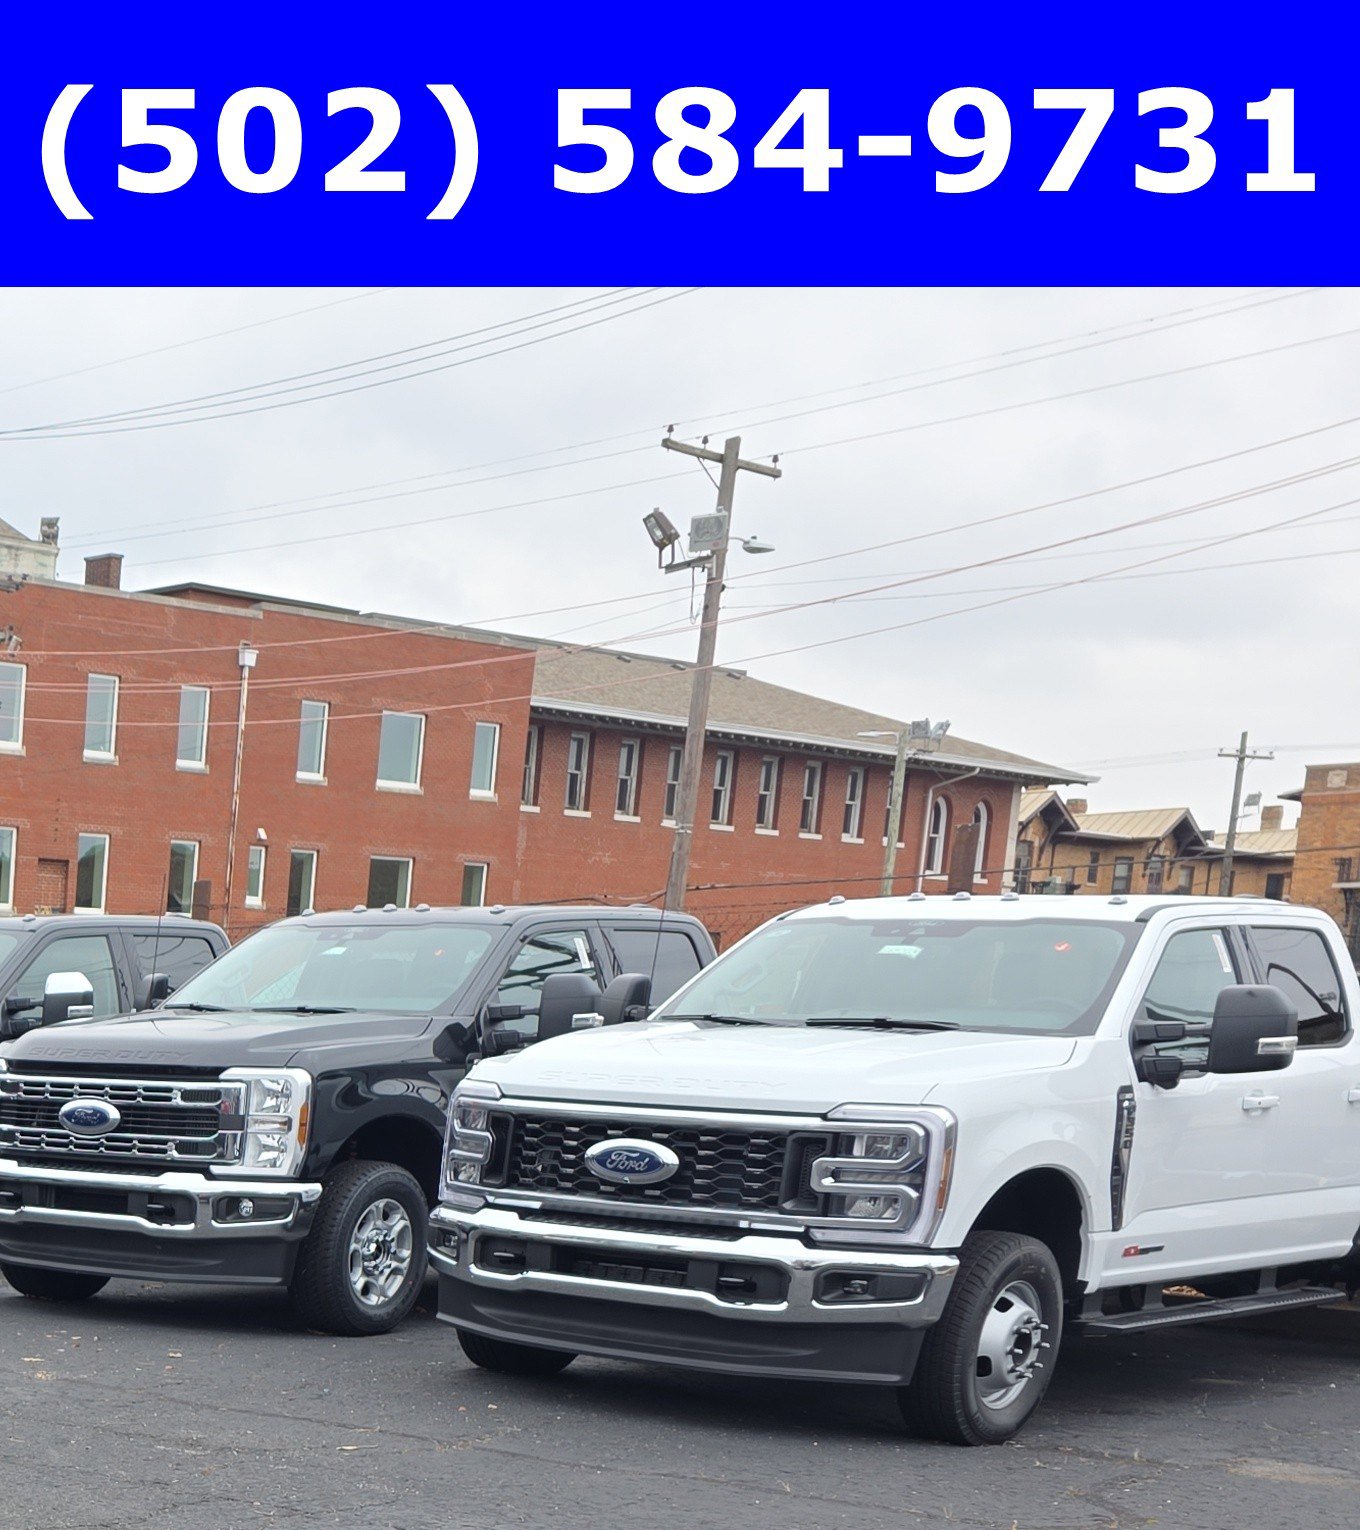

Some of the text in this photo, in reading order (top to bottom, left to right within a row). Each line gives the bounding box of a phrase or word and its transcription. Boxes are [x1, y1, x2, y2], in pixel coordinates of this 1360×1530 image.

[26, 1046, 194, 1063] SUPER DUTY
[536, 1069, 665, 1088] SUPER
[605, 1150, 650, 1172] Ford
